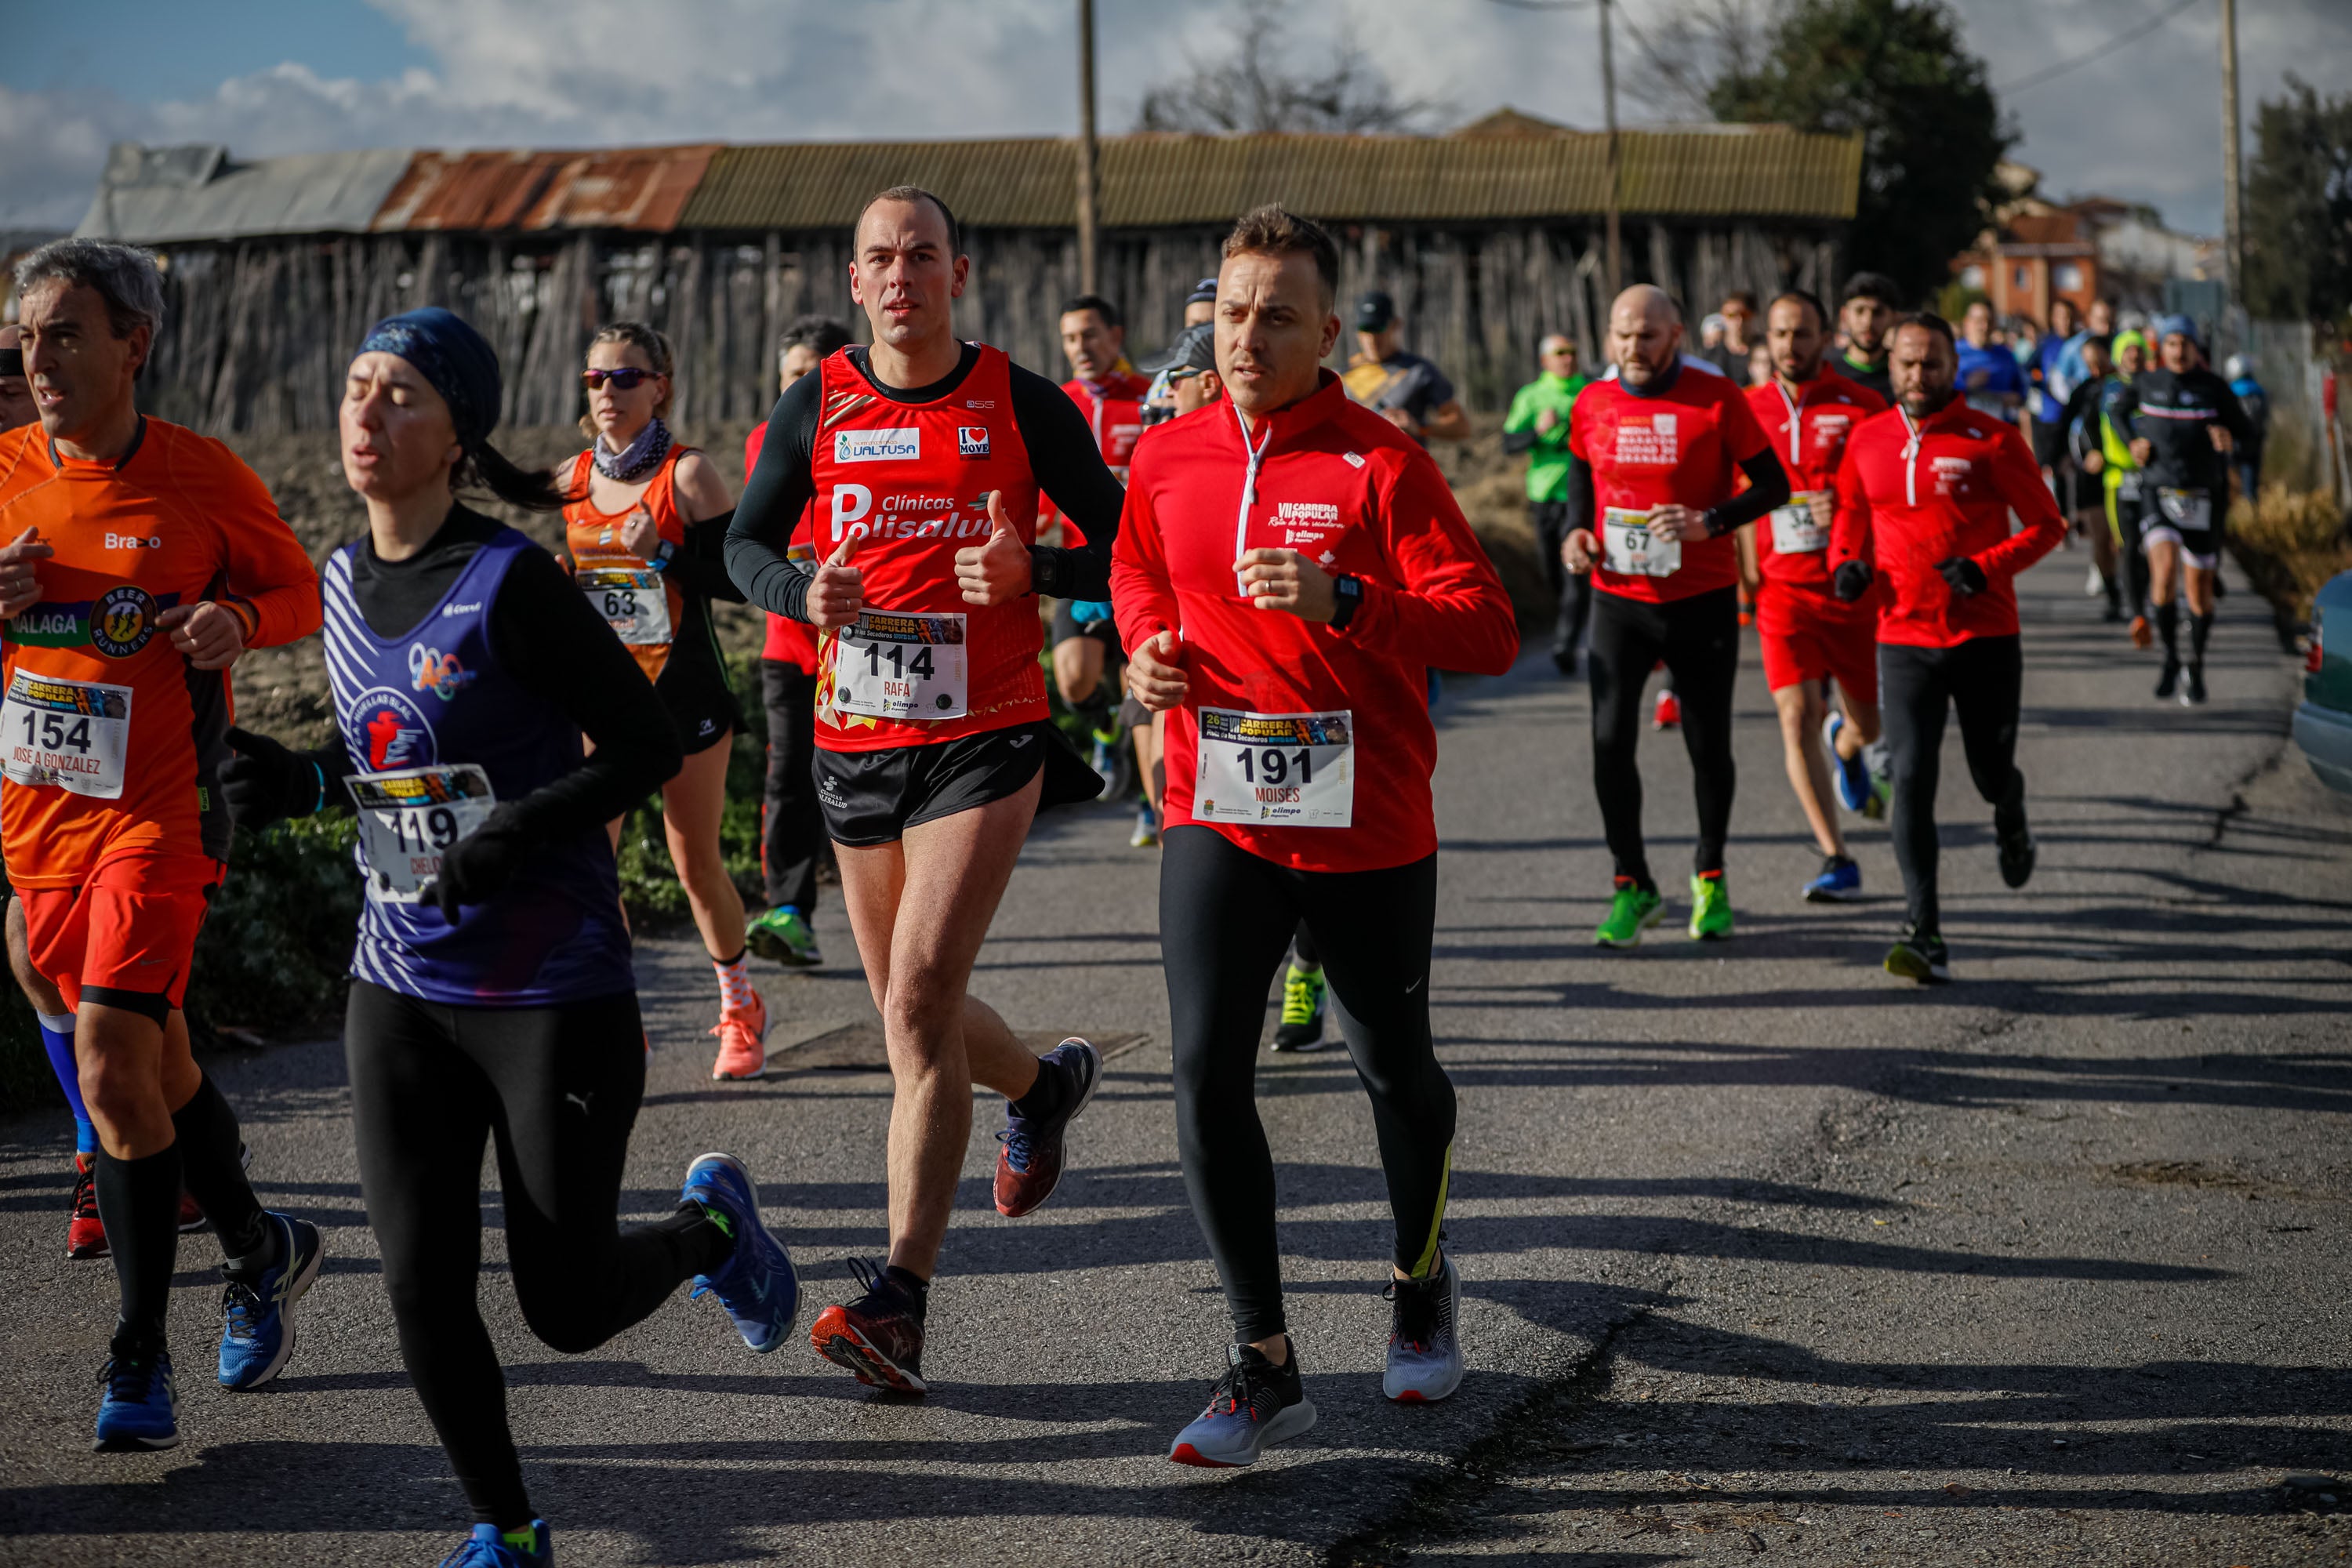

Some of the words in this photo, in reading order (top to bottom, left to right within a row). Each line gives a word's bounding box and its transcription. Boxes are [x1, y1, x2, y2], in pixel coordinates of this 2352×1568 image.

[960, 445, 989, 453] MOVE
[882, 495, 955, 512] Clínicas
[1277, 502, 1293, 518] VII
[1292, 503, 1338, 513] CARRERA
[1288, 516, 1298, 526] de
[1292, 510, 1338, 521] POPULAR
[1296, 530, 1325, 541] olimpo
[1625, 530, 1650, 550] 67
[106, 589, 147, 605] BEER
[604, 592, 636, 616] 63
[869, 615, 915, 626] CARRERA
[866, 630, 893, 639] Secaderos
[869, 623, 916, 633] POPULAR
[93, 626, 153, 654] RUNNERS
[864, 643, 935, 681] 114
[28, 681, 74, 695] CARRERA
[884, 681, 910, 697] RAFA
[27, 689, 74, 703] POPULAR
[1207, 713, 1221, 726] 26
[1240, 718, 1293, 729] CARRERA
[23, 710, 92, 754] 154
[1237, 733, 1268, 742] Secaderos
[1240, 726, 1294, 736] POPULAR
[13, 746, 33, 764] JOSE
[34, 751, 42, 765] A
[44, 753, 101, 775] GONZALEZ
[1237, 747, 1312, 784] 191
[1255, 785, 1301, 803] MOISÉS
[1272, 807, 1301, 815] olimpo
[393, 808, 459, 853] 119
